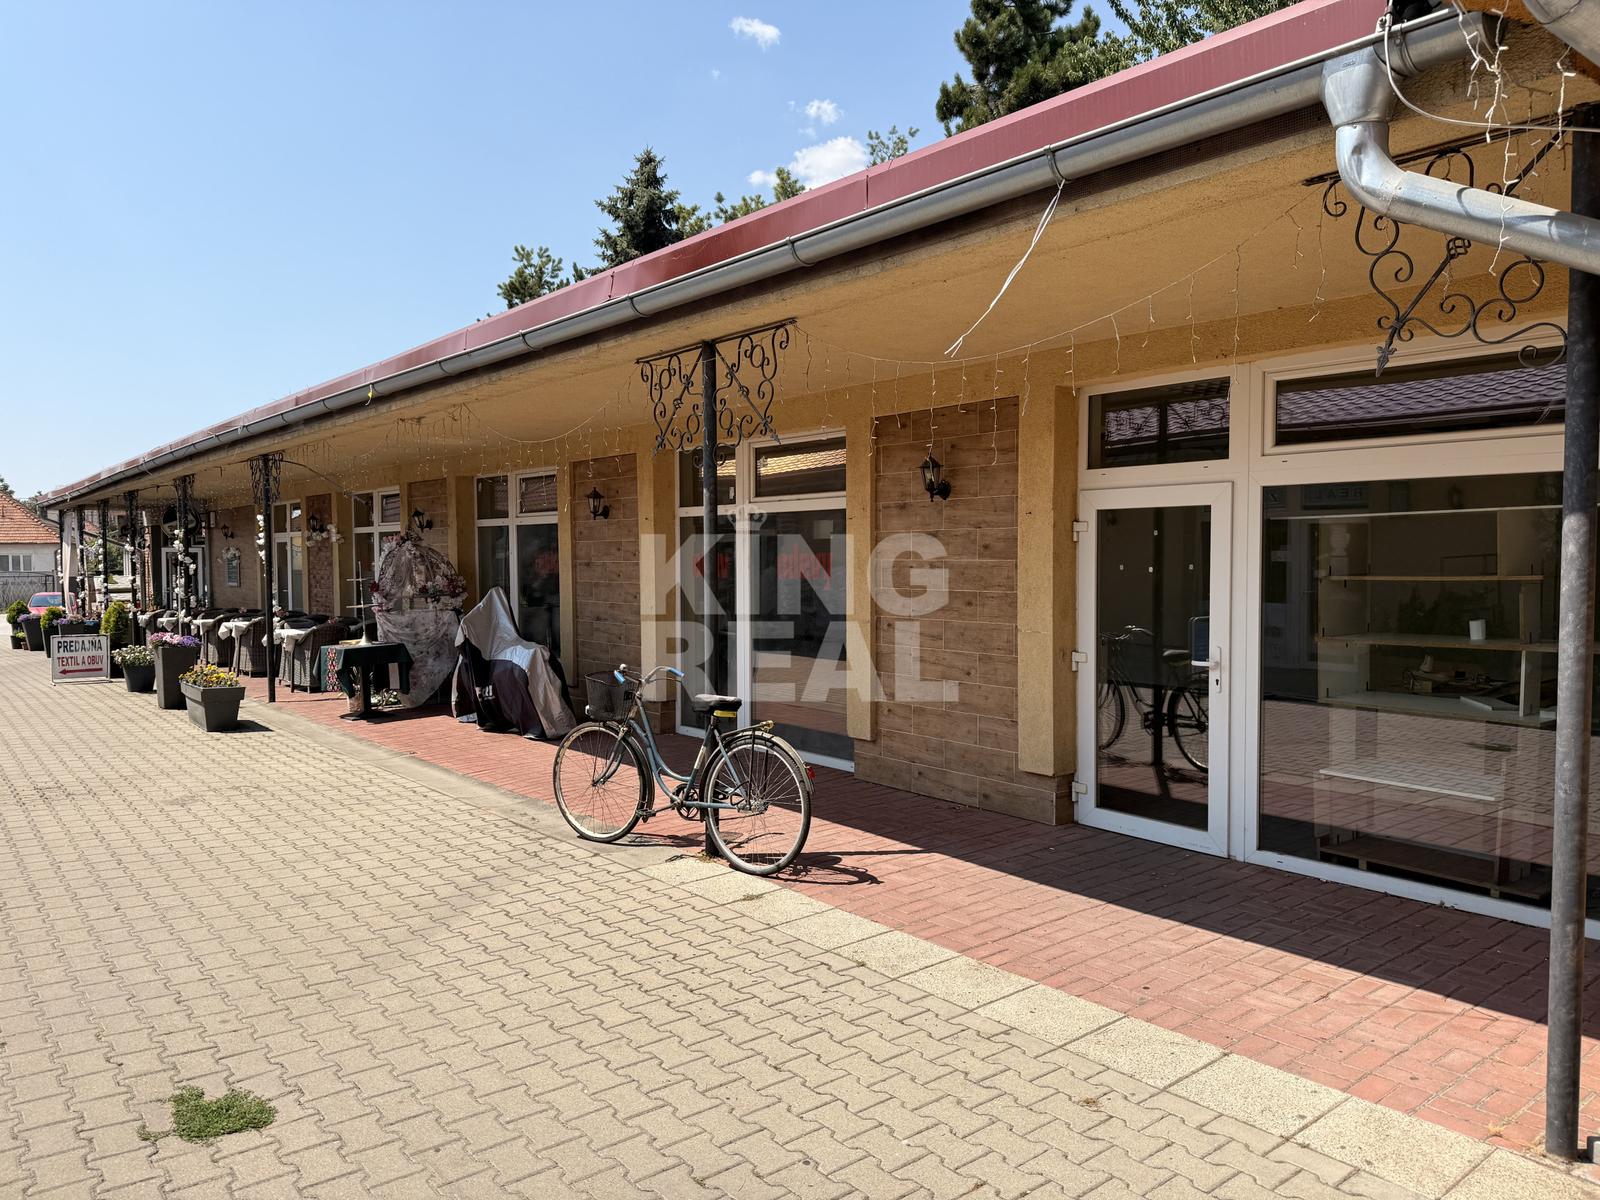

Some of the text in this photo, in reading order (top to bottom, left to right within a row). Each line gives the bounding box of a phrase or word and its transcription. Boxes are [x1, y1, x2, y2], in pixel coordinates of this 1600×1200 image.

[57, 637, 103, 654] PREDAJŇA
[57, 655, 104, 667] TEXTIL A OBUV
